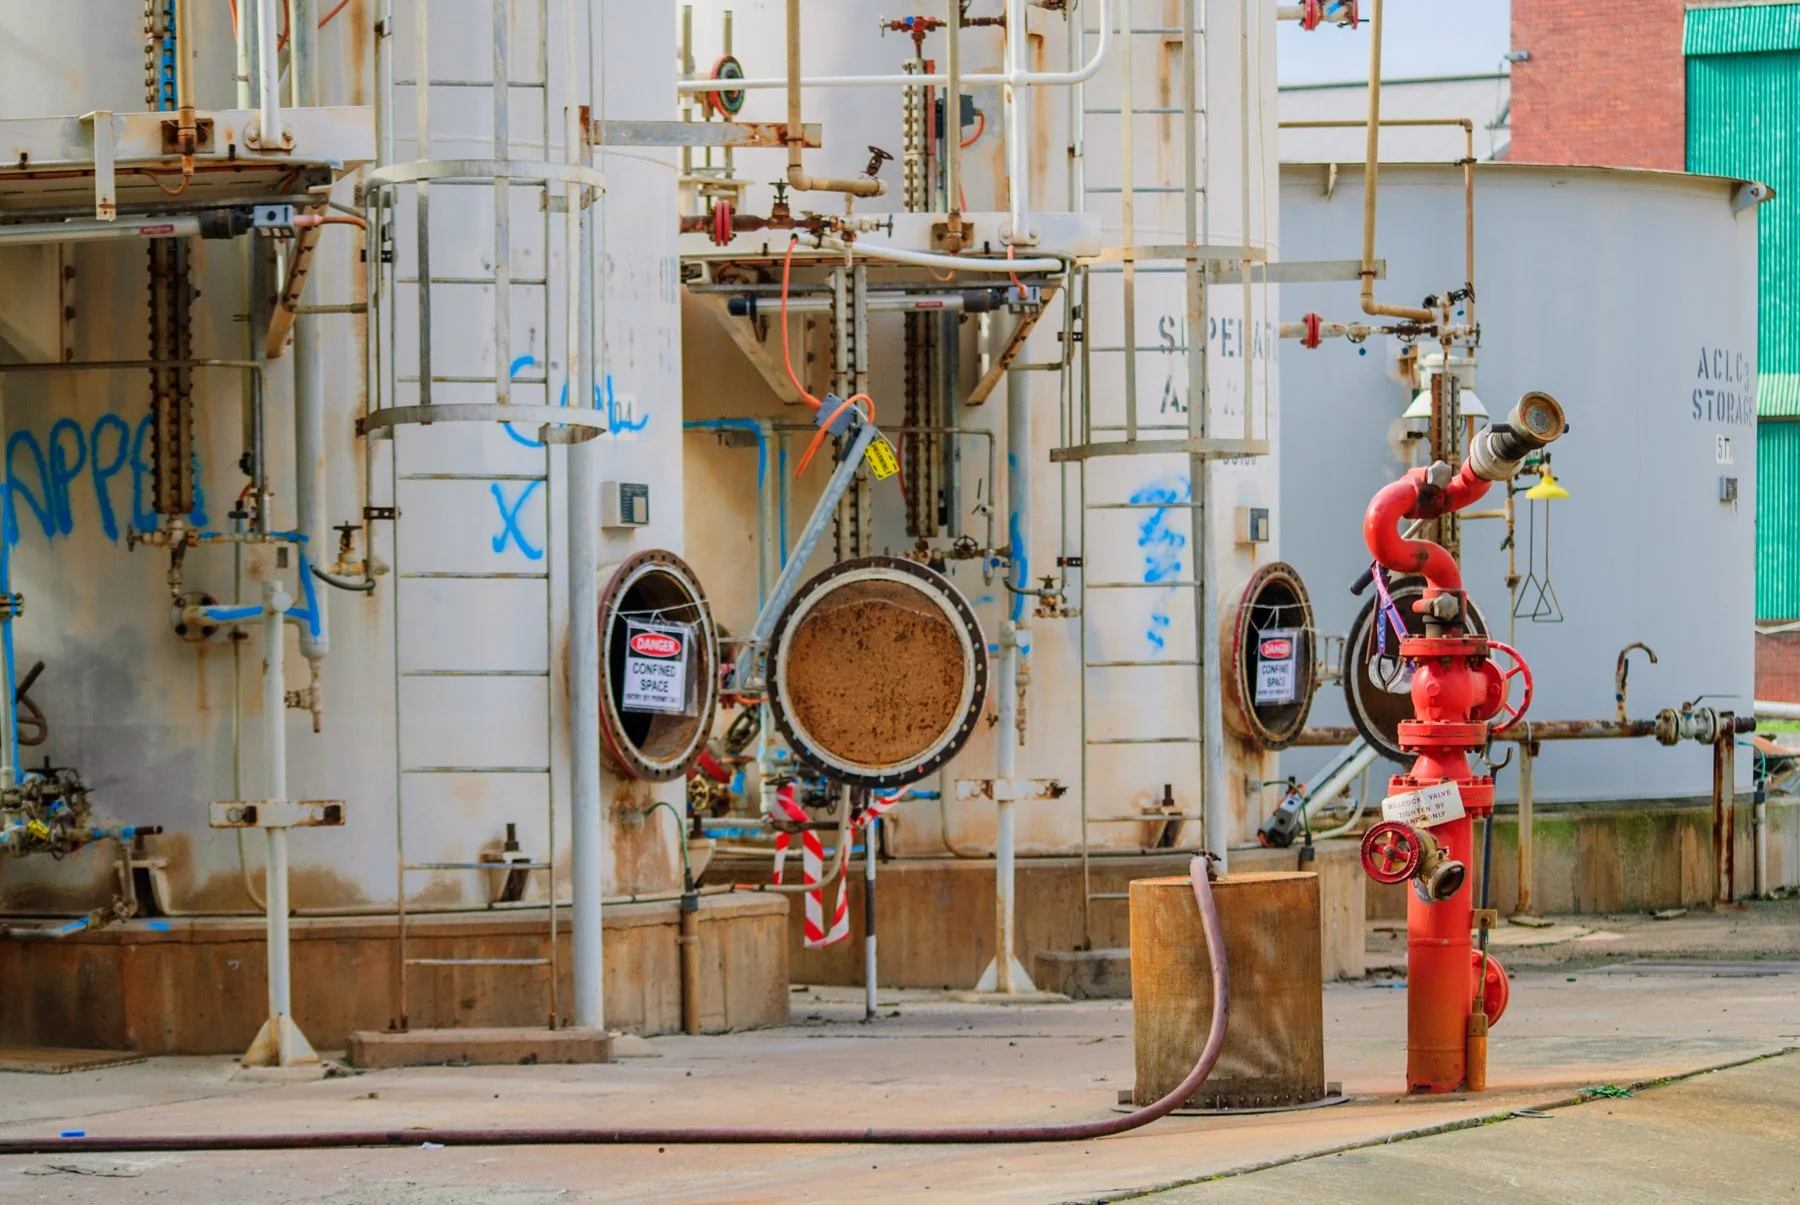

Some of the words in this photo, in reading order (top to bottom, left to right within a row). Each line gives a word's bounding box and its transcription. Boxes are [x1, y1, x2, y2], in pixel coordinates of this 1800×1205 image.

[1692, 388, 1754, 428] STORAGE
[491, 480, 543, 560] X
[636, 637, 676, 653] DANGER
[1264, 643, 1289, 655] DANGER
[632, 662, 676, 677] CONFINED
[640, 679, 669, 693] SPACE
[1266, 677, 1286, 688] SPACE
[1428, 789, 1451, 800] VALVE
[1399, 806, 1431, 818] TIGHTEN
[1429, 811, 1446, 820] ONLY
